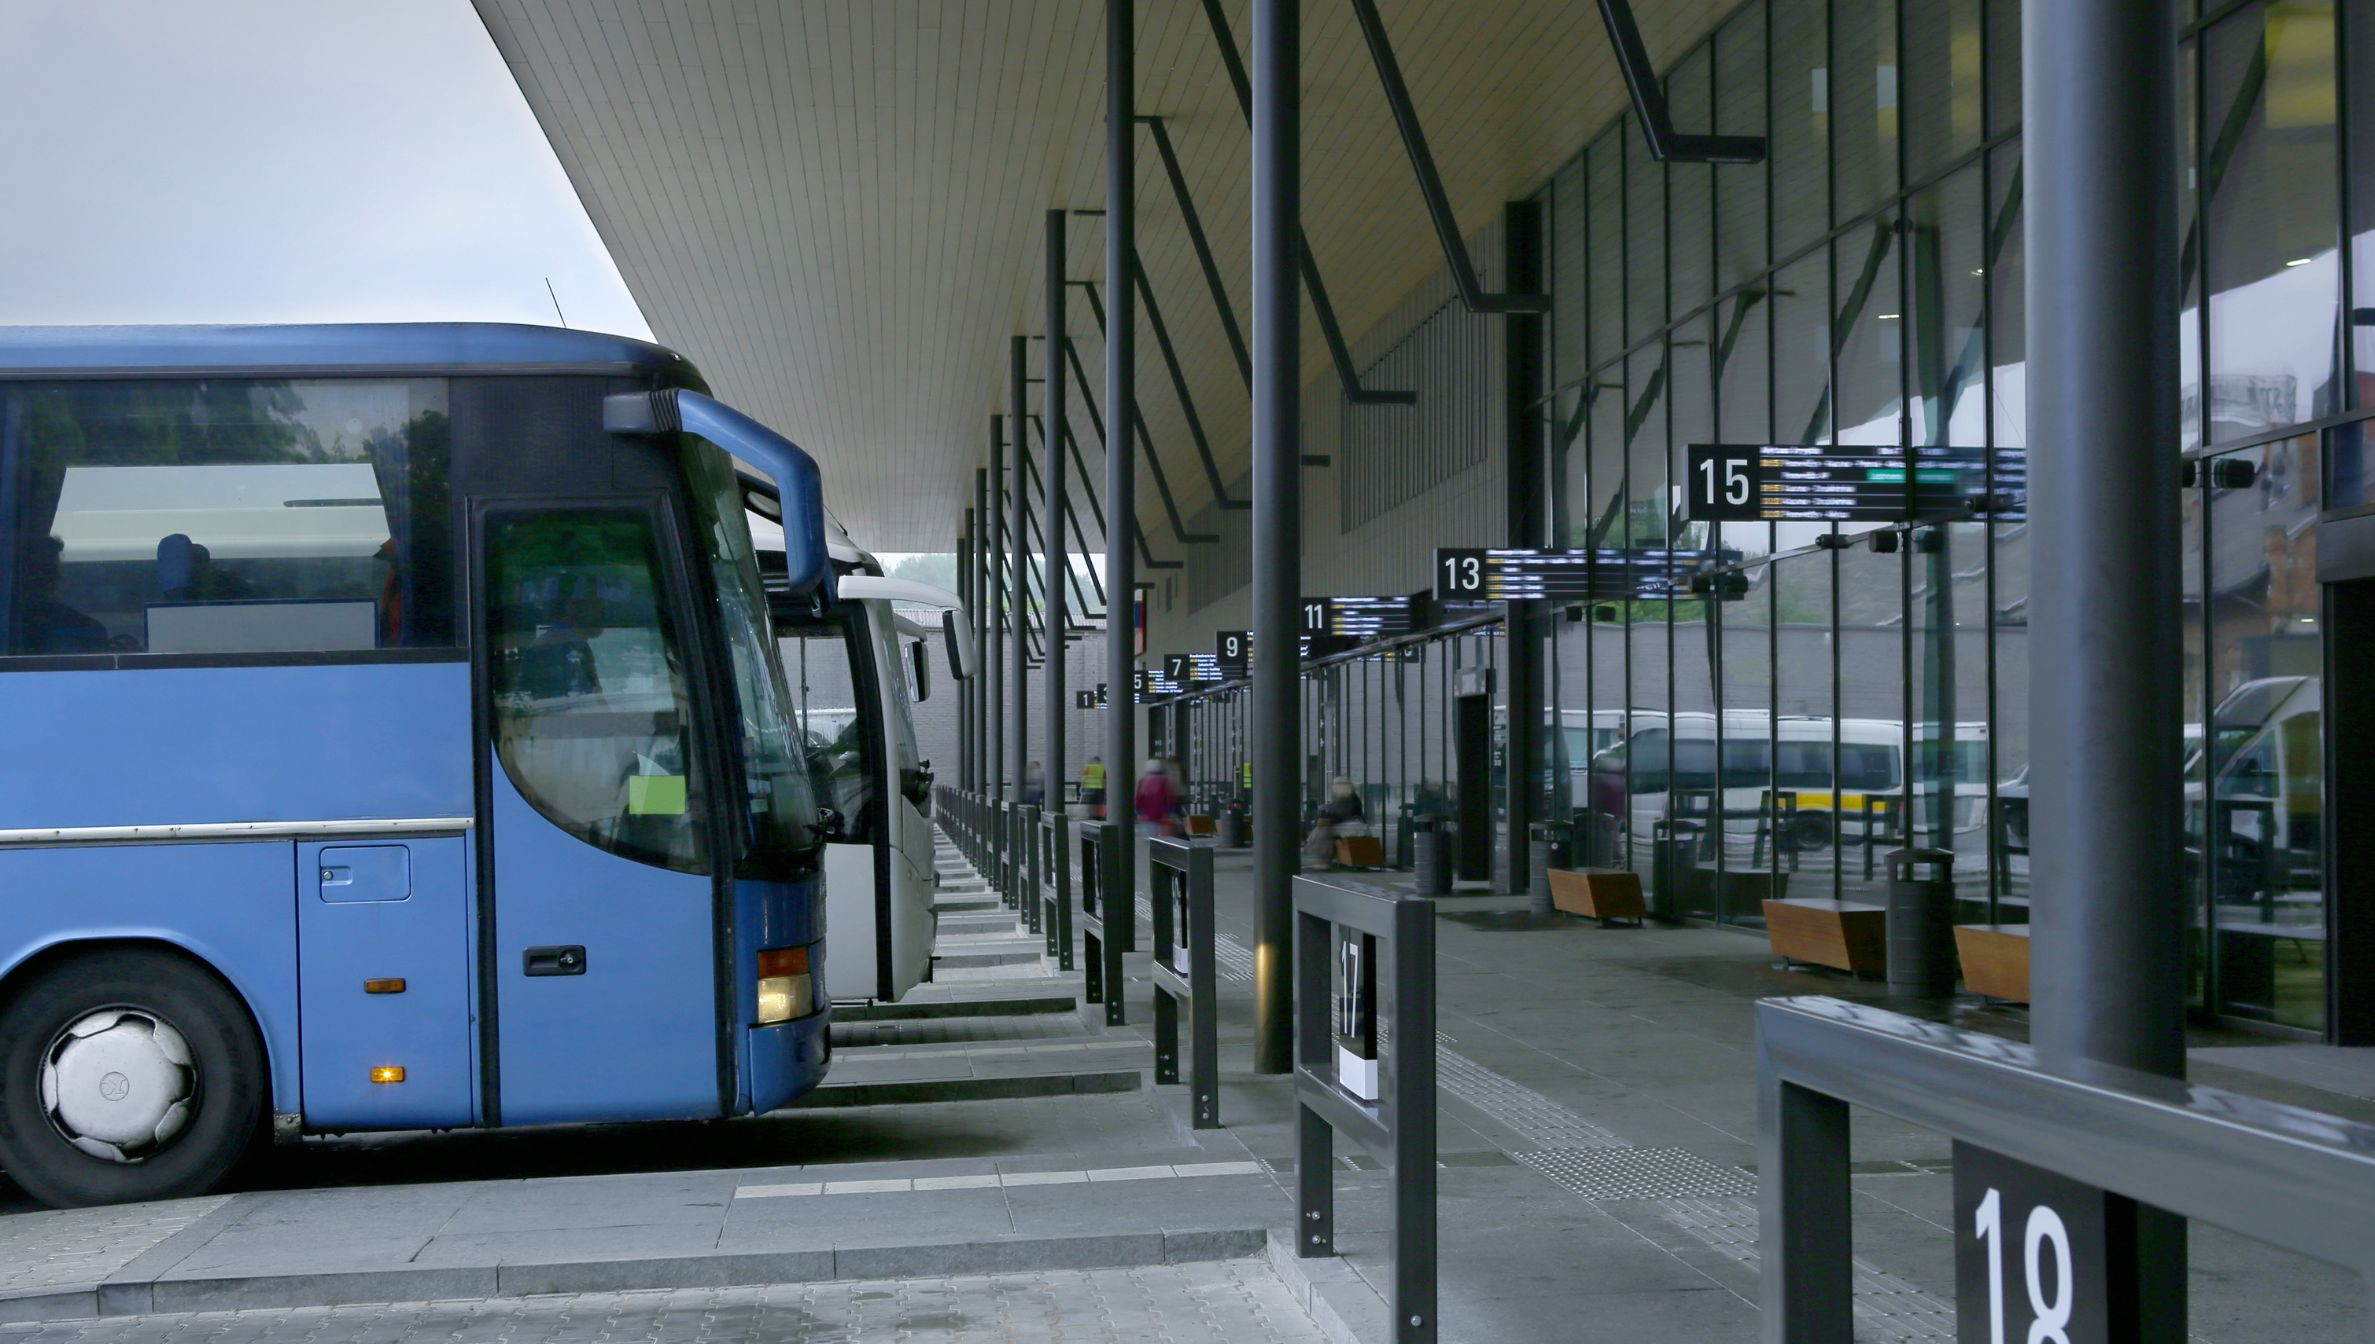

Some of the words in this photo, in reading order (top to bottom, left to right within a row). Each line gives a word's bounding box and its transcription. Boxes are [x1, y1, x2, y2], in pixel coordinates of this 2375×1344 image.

[1699, 459, 1749, 505] 15
[1445, 558, 1480, 590] 13
[1304, 604, 1323, 630] 11
[1226, 637, 1239, 658] 9
[1171, 658, 1182, 677] 7
[1134, 674, 1142, 690] 5
[1082, 693, 1089, 707] 1
[1341, 940, 1359, 1039] 17
